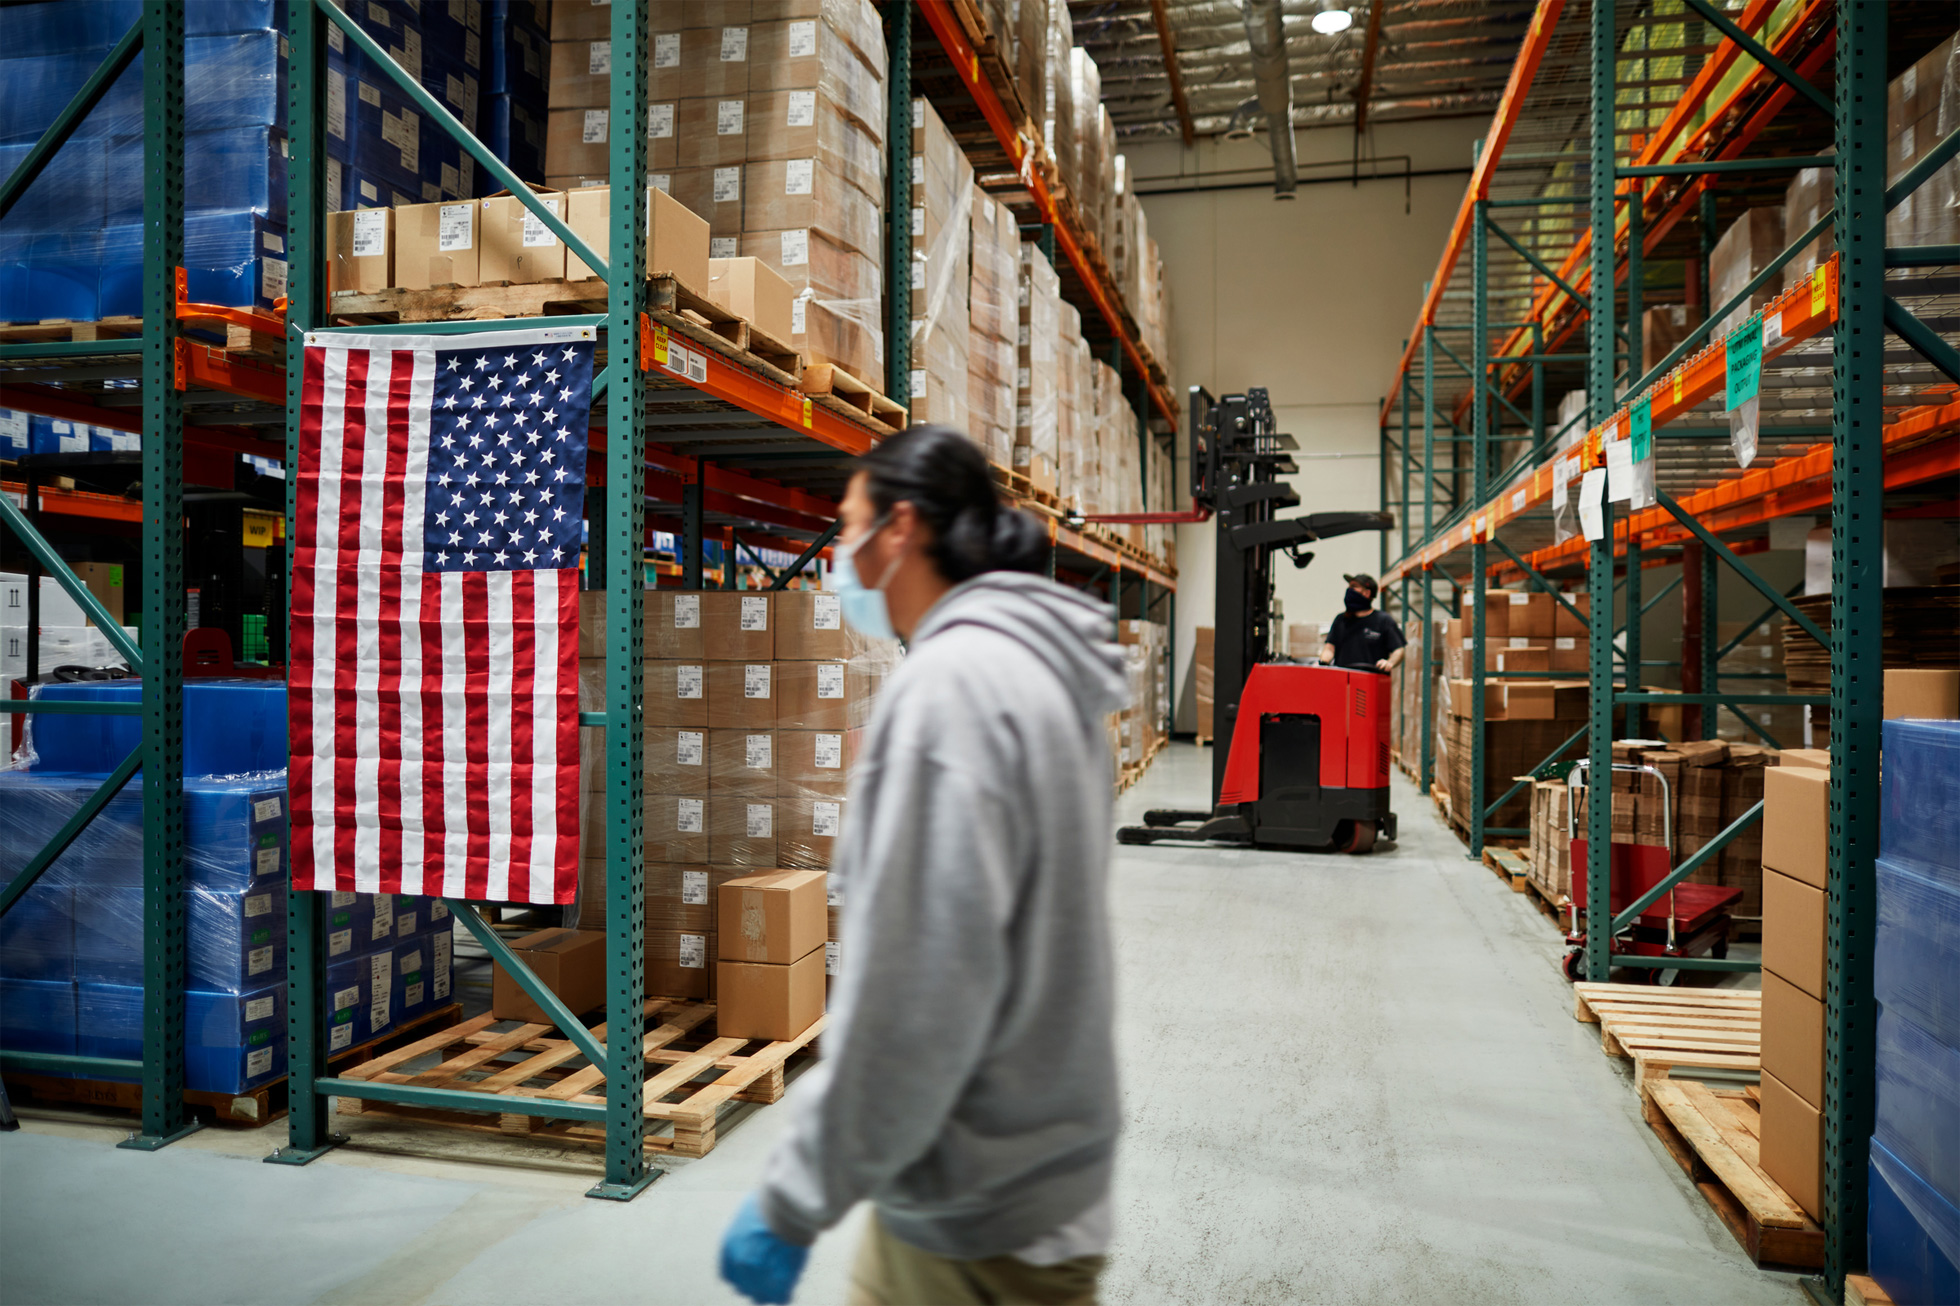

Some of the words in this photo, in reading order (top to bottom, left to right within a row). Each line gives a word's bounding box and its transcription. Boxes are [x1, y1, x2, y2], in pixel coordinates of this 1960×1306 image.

[656, 335, 666, 344] KEEP
[655, 343, 667, 352] CLEAR
[1731, 349, 1758, 375] PACKAGING
[249, 525, 267, 536] WIP
